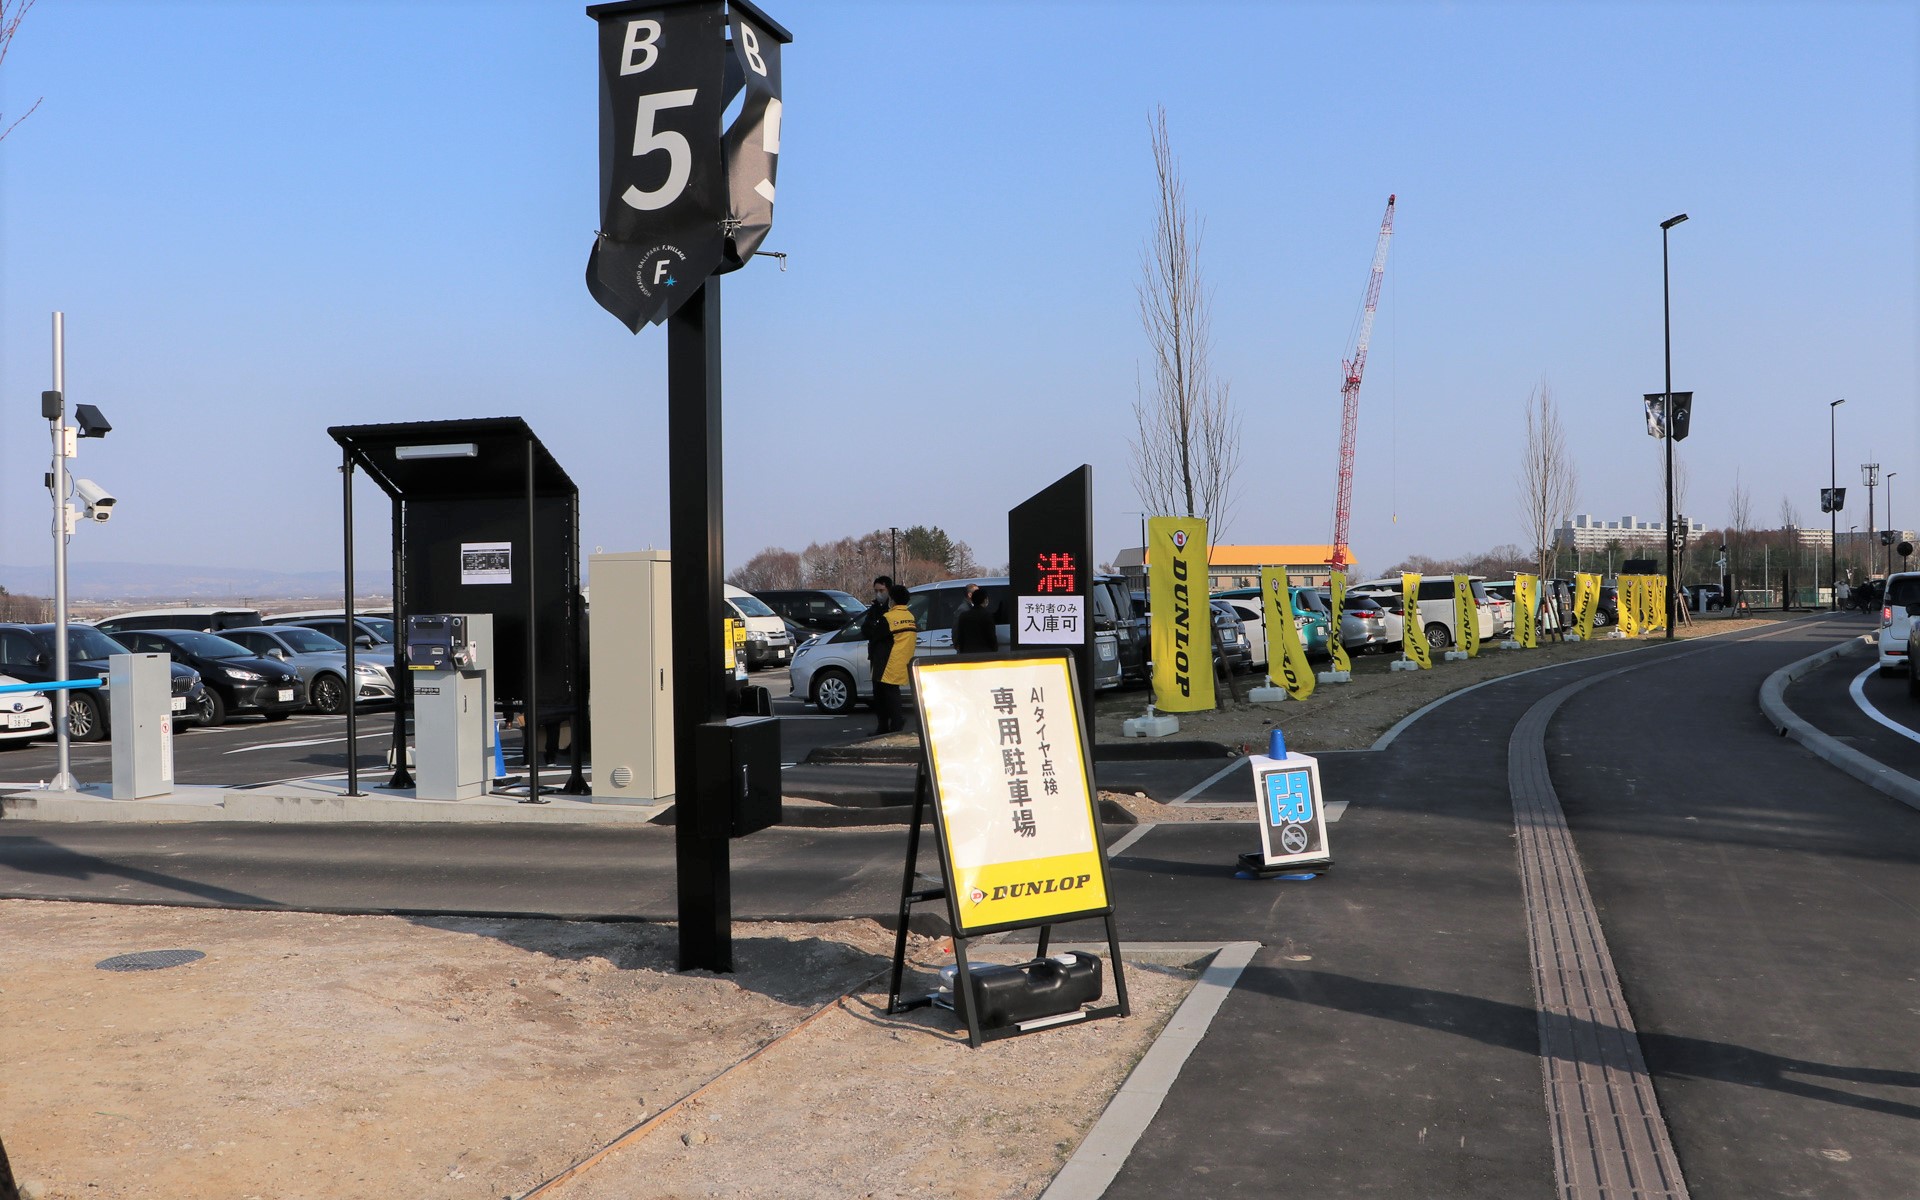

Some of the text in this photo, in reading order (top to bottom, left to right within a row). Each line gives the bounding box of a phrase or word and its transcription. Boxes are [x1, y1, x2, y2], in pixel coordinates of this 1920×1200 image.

[620, 19, 662, 76] B
[740, 21, 767, 77] B
[621, 88, 698, 211] 5
[1037, 552, 1076, 592] 満
[1024, 602, 1078, 614] 予約者のみ
[1024, 614, 1078, 633] 入庫可
[1172, 555, 1190, 698] DUNLOP
[990, 686, 1037, 838] 専用駐車場
[1265, 770, 1314, 827] 閉
[990, 874, 1091, 901] DUNLOP
